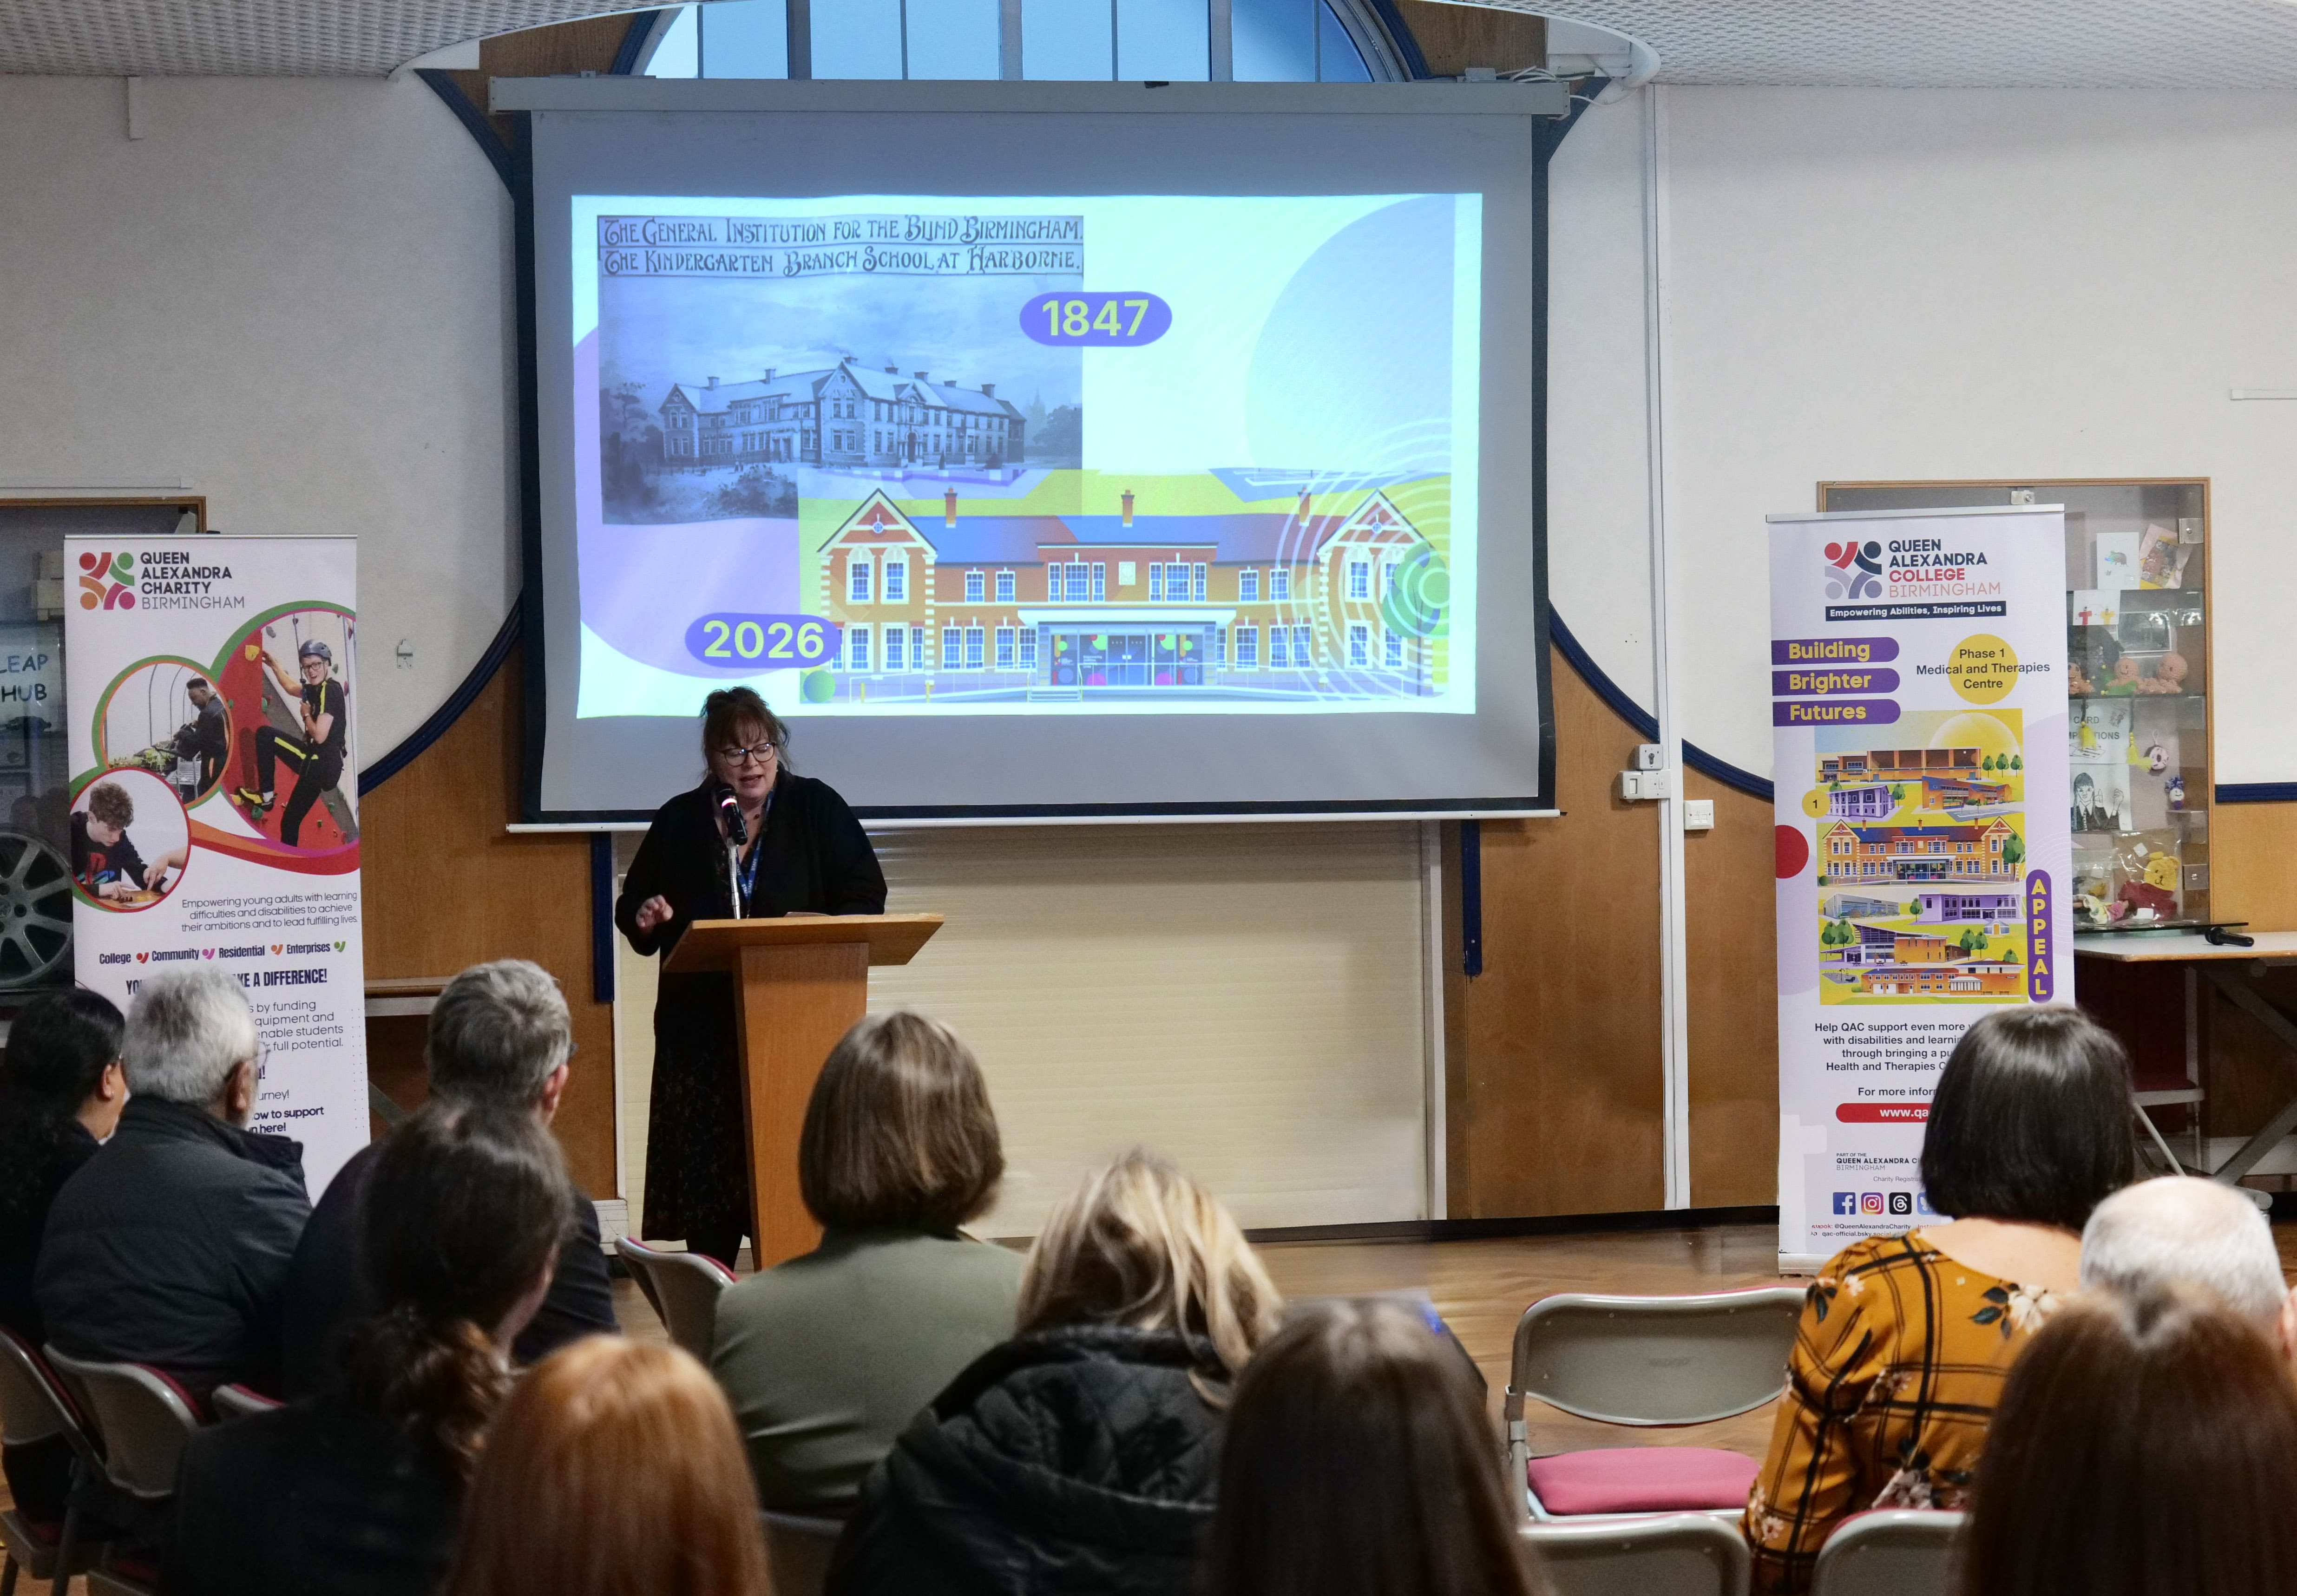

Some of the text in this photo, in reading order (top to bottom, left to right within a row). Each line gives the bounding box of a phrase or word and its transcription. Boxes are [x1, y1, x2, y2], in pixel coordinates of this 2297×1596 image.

[1041, 299, 1149, 337] 1847
[1889, 539, 1941, 553] QUEEN
[140, 552, 190, 565] QUEEN
[1889, 552, 1988, 568] ALEXANDRA
[141, 567, 232, 580] ALEXANDRA
[1889, 568, 1965, 582] COLLEGE
[142, 582, 212, 595] CHARITY
[1890, 582, 2001, 598] BIRMINGHAM
[142, 596, 245, 609] BIRMINGHAM
[1830, 603, 2002, 617] Empowering Abilities, Inspiring Lives
[703, 619, 824, 658] 2026
[1789, 641, 1870, 662] Building
[1959, 648, 2004, 659] Phase 1
[1916, 662, 2050, 675] Medical and Therapies
[1790, 673, 1871, 694] Brighter
[1963, 679, 2003, 689] Centre
[1, 684, 47, 702] HUB
[1790, 704, 1866, 721] Futures
[1813, 799, 1818, 809] 1
[182, 892, 357, 909] Empowering young adults with learning
[190, 909, 236, 920] difficulties
[237, 908, 256, 917] and
[257, 906, 306, 916] disabilities
[318, 903, 352, 913] achieve
[182, 923, 202, 932] their
[204, 920, 250, 931] ambitions
[252, 919, 271, 928] and
[284, 916, 305, 926] lead
[307, 916, 339, 926] fulfilling
[2031, 878, 2048, 995] APPEAL
[99, 942, 330, 964] College Community Residential Enterprises
[253, 973, 260, 987] A
[263, 968, 327, 986] DIFFERENCE!
[257, 1003, 270, 1014] by
[273, 1001, 316, 1011] funding
[255, 1012, 334, 1027] quipment and
[295, 1025, 343, 1036] students
[1815, 1023, 1838, 1033] Help
[1841, 1023, 1864, 1032] QAC
[1868, 1023, 1908, 1033] support
[273, 1041, 289, 1051] full
[292, 1037, 343, 1052] potential.
[1823, 1036, 1844, 1045] with
[1848, 1036, 1903, 1044] disabilities
[1842, 1049, 1882, 1060] through
[1885, 1049, 1928, 1059] bringing
[1826, 1062, 1859, 1071] Health
[1863, 1062, 1882, 1071] and
[1884, 1062, 1936, 1072] Therapies
[257, 1090, 289, 1101] urney!
[1858, 1087, 1875, 1096] For
[252, 1106, 324, 1120] ow to support
[1879, 1109, 1929, 1119] www.qa
[260, 1122, 286, 1133] here!
